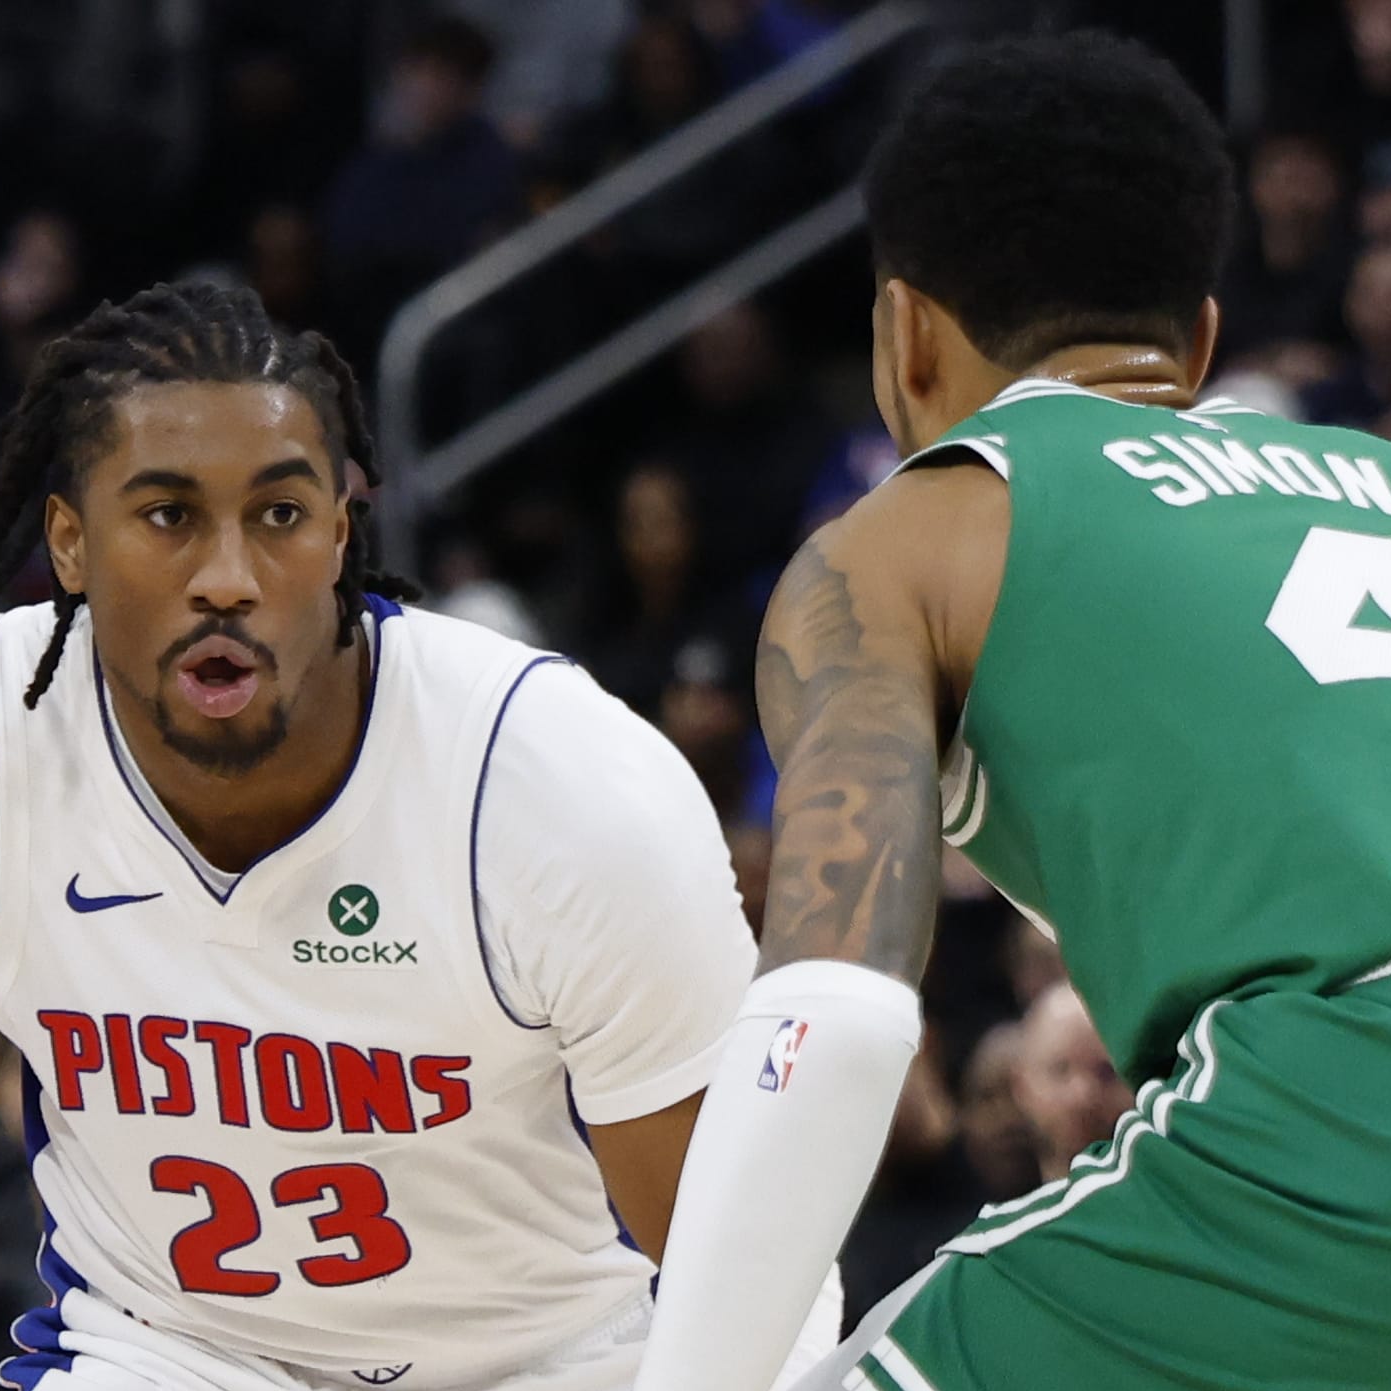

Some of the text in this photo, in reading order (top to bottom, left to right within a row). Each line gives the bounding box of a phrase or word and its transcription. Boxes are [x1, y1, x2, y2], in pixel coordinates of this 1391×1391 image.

[292, 938, 418, 965] StockX
[36, 1009, 472, 1134] PISTONS
[149, 1155, 412, 1297] 23
